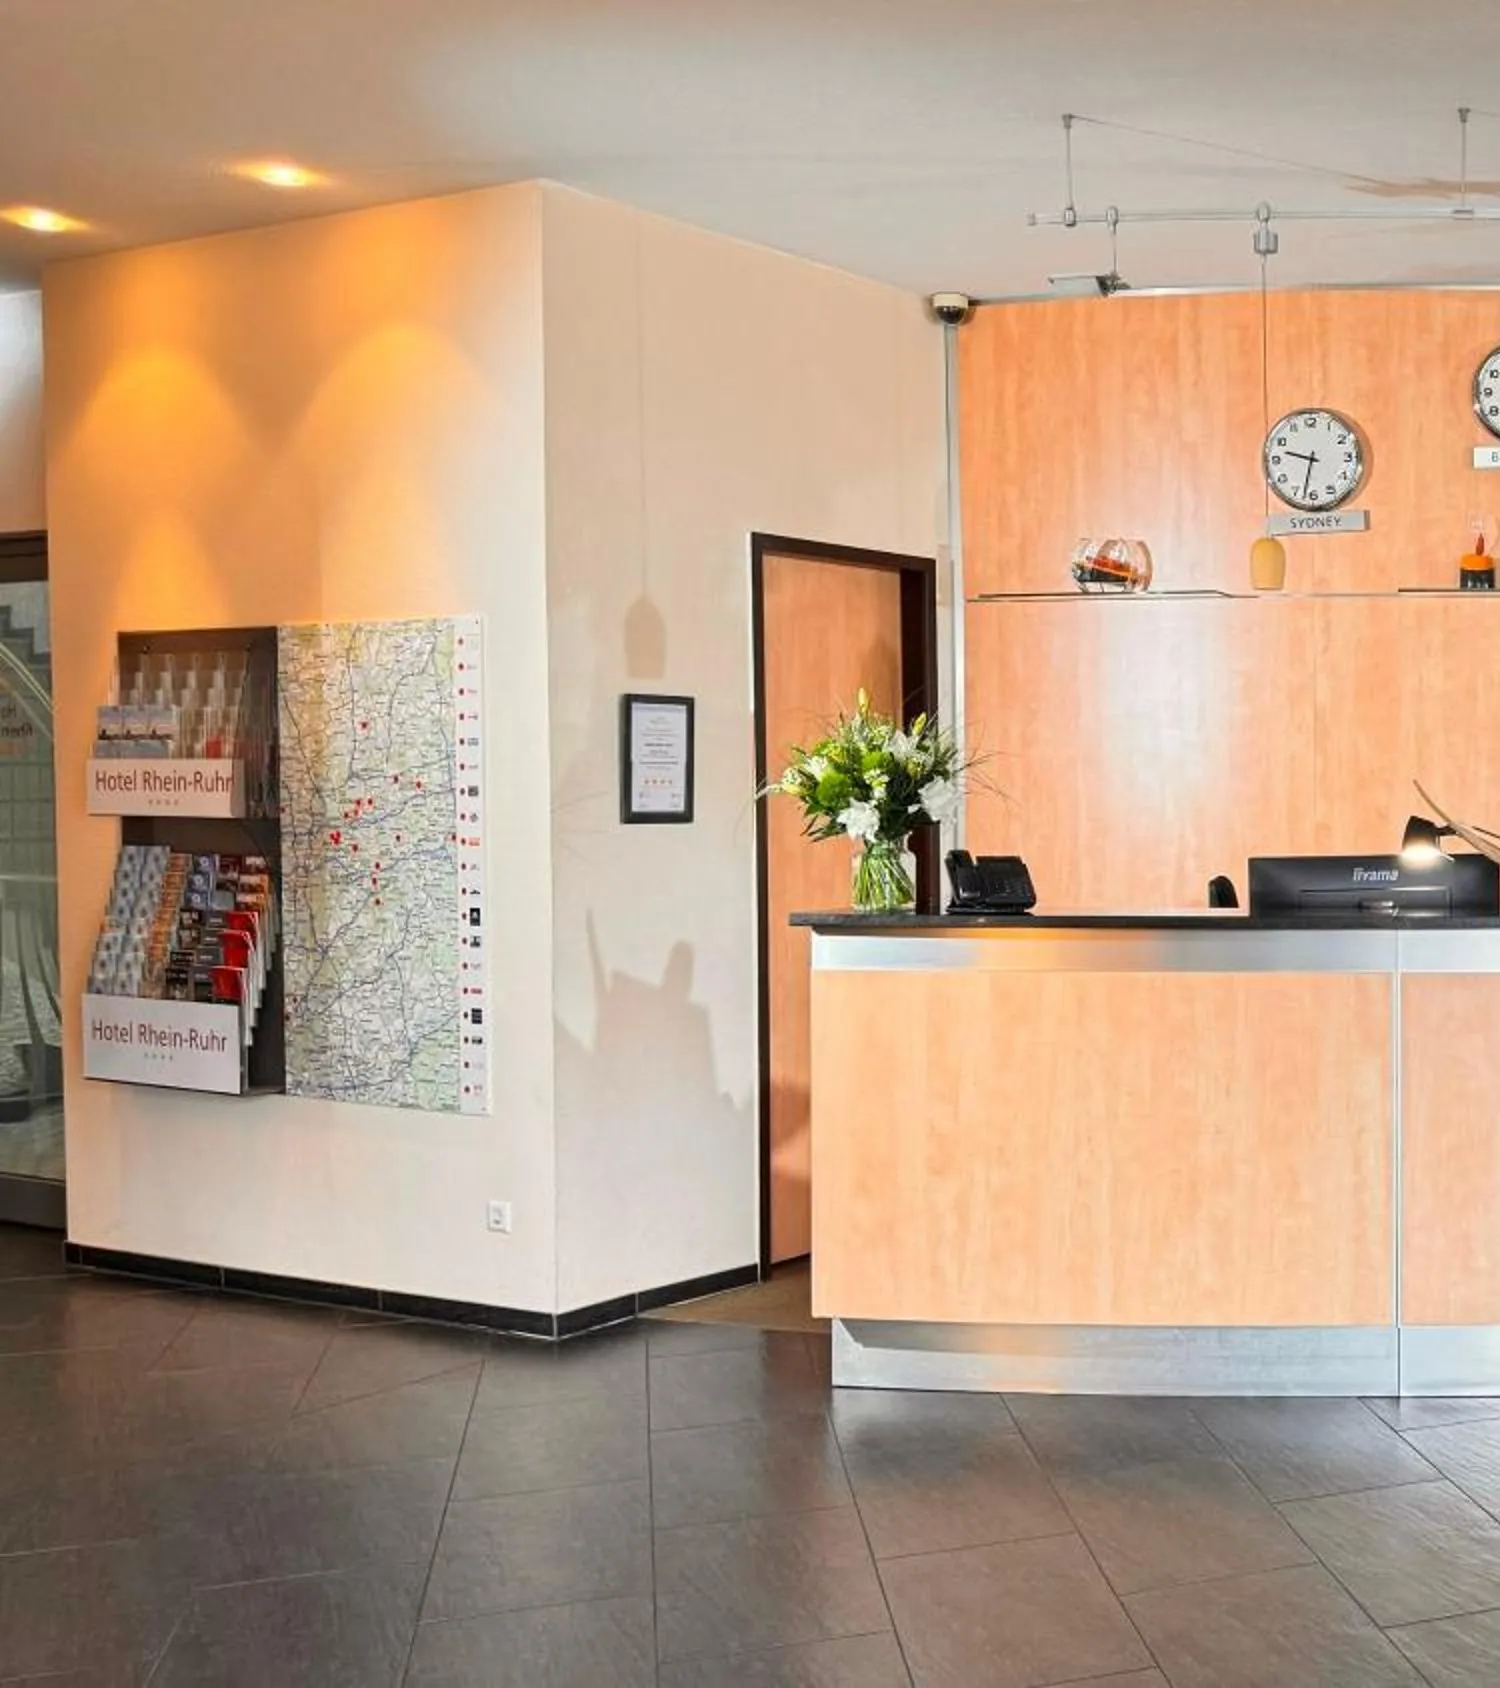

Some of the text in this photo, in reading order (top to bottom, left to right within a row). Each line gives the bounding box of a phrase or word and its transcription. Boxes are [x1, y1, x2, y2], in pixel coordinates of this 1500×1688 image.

[1489, 369, 1500, 378] 10
[1484, 387, 1493, 398] 9
[1489, 406, 1499, 416] 8
[1304, 418, 1317, 428] 12
[1337, 434, 1346, 445] 2
[1344, 452, 1352, 462] 3
[1291, 486, 1300, 496] 7
[1309, 490, 1318, 500] 6
[1290, 516, 1342, 528] SYDNEY
[95, 769, 234, 792] Hotel Rhein-Ruhr
[92, 1018, 228, 1052] Hotel Rhein-Ruhr
